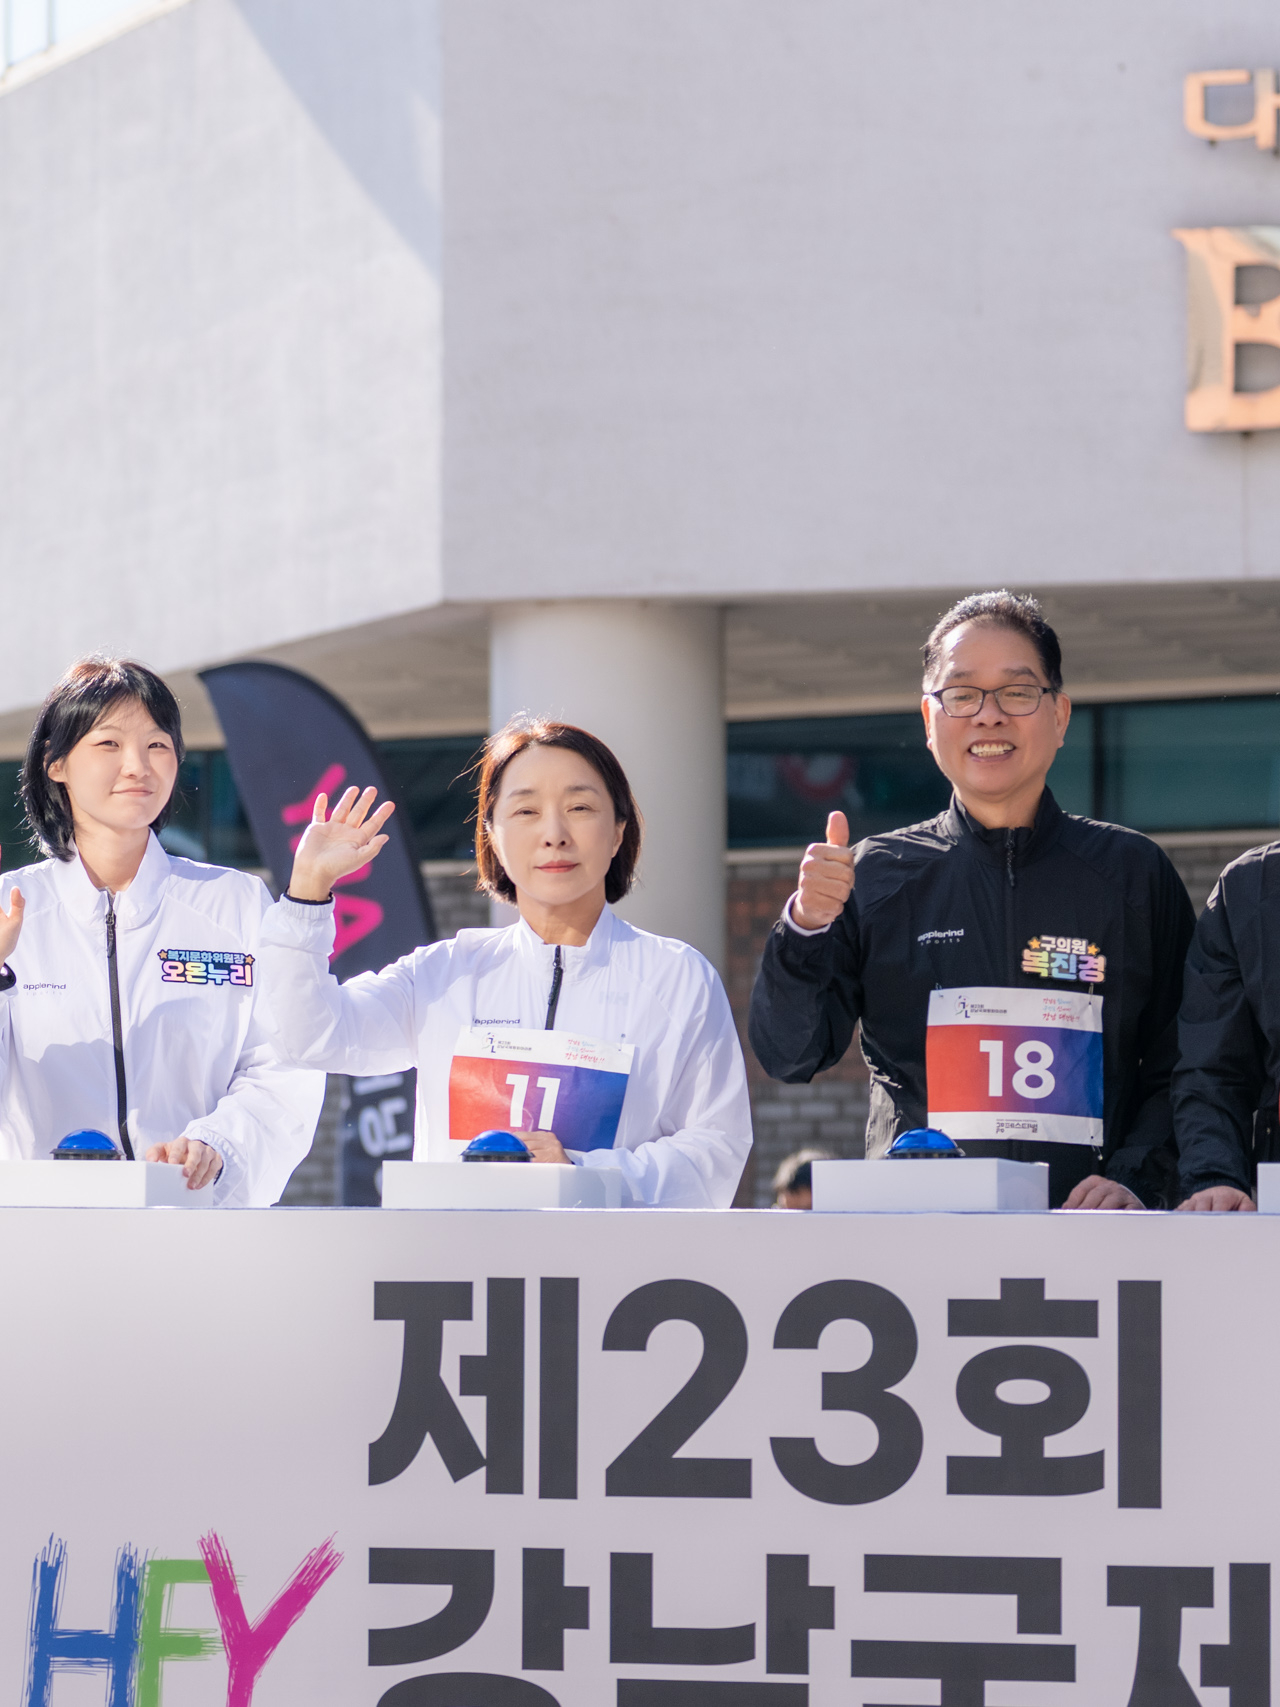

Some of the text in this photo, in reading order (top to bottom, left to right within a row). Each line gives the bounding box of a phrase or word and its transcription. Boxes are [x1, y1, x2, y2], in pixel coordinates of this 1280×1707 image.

[167, 950, 245, 965] 복지문화위원장
[1040, 936, 1087, 955] 구의원
[162, 961, 252, 986] 오온누리
[1021, 948, 1106, 983] 복진경
[979, 1040, 1056, 1099] 18
[505, 1073, 561, 1131] 11
[368, 1276, 1163, 1510] 제23회
